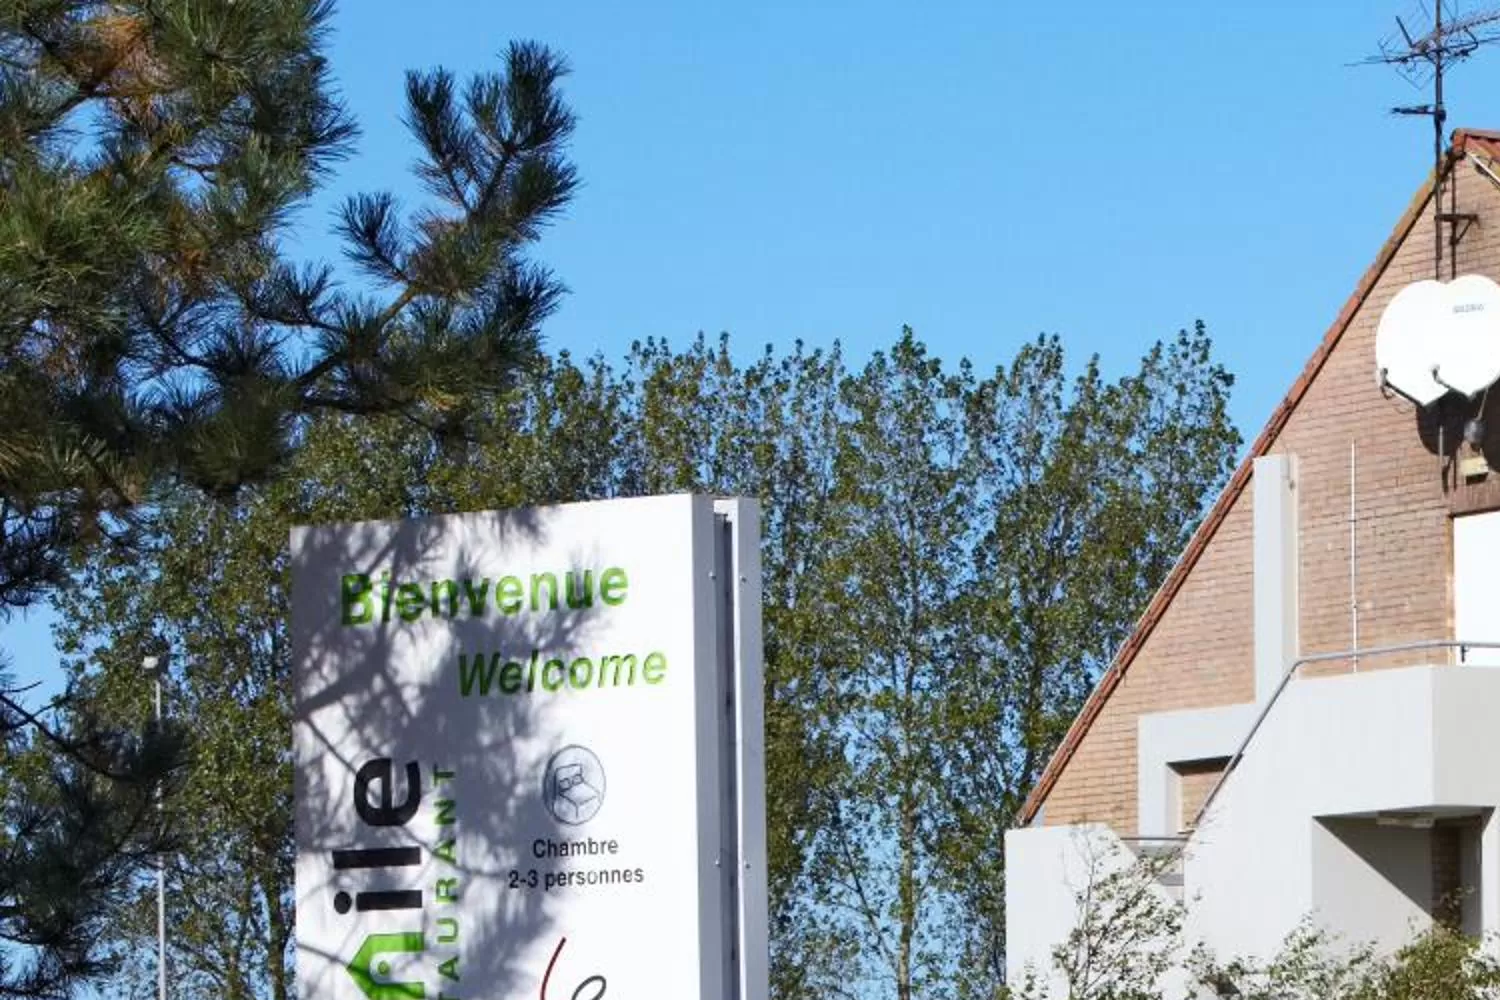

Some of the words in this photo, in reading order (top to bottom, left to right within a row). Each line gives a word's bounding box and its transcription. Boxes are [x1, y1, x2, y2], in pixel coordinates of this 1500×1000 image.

[341, 567, 629, 626] Bienvenue
[459, 650, 668, 697] Welcome
[532, 837, 620, 858] Chambre
[508, 869, 539, 889] 2-3
[544, 867, 645, 891] personnes
